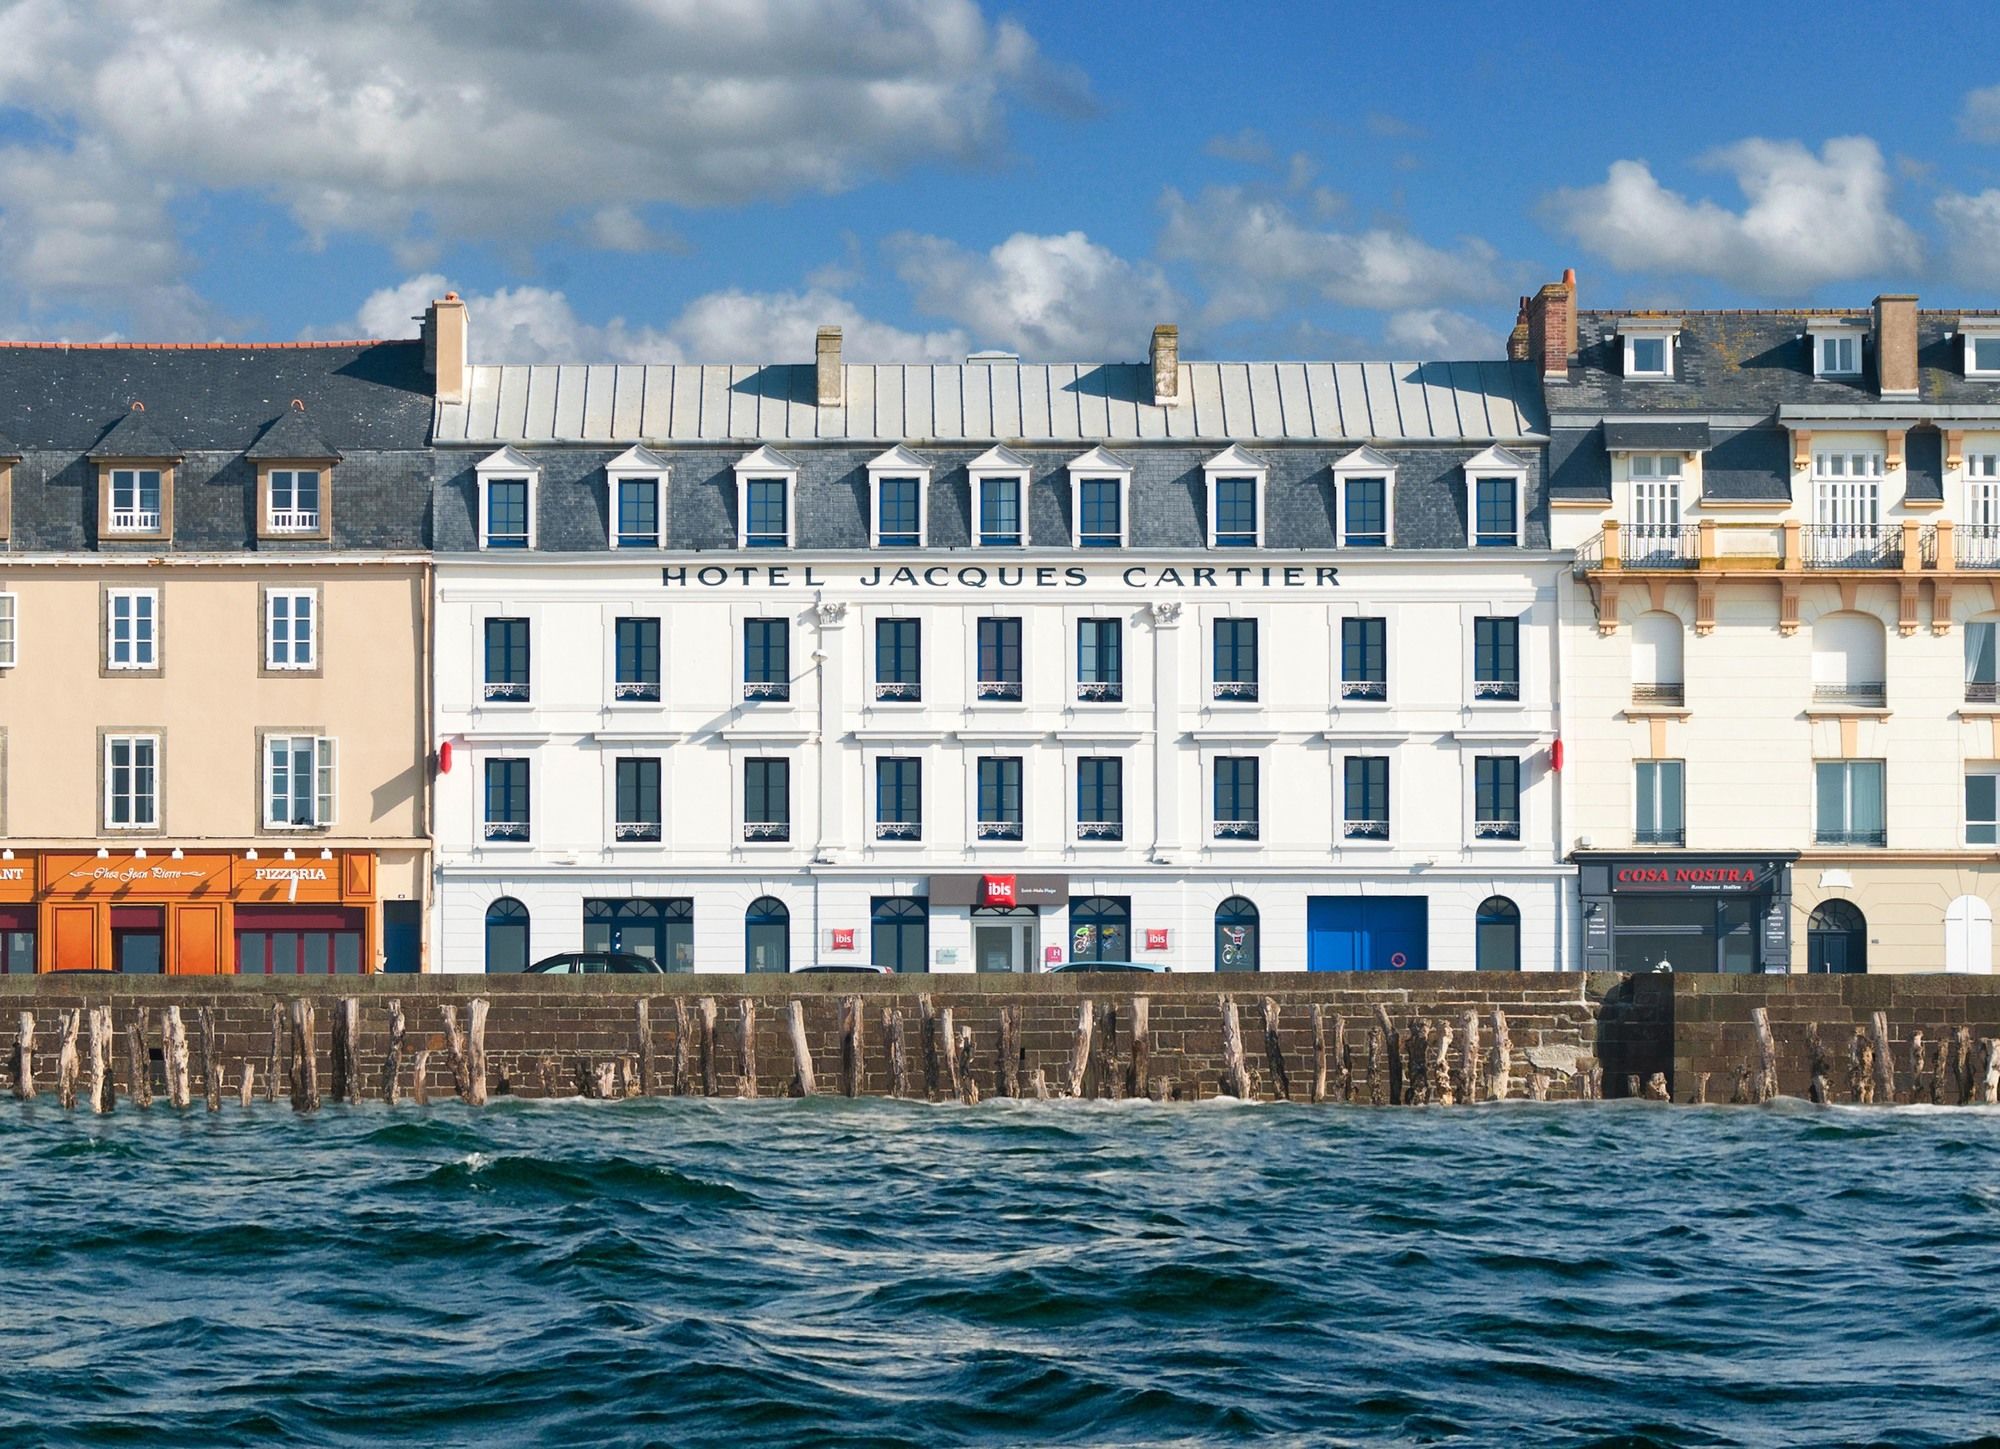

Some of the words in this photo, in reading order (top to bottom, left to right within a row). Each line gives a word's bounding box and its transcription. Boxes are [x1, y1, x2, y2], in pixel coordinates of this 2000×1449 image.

[661, 566, 825, 586] HOTEL
[860, 566, 1088, 588] JACQUES
[1123, 566, 1341, 588] CARTIER
[93, 867, 119, 879] Chez
[120, 867, 148, 882] Jean
[151, 867, 182, 879] Pierre
[1618, 868, 1669, 882] COSA
[1675, 868, 1756, 882] NOSTRA
[988, 882, 1012, 896] ibis
[835, 934, 852, 944] ibis
[1149, 934, 1166, 944] ibis
